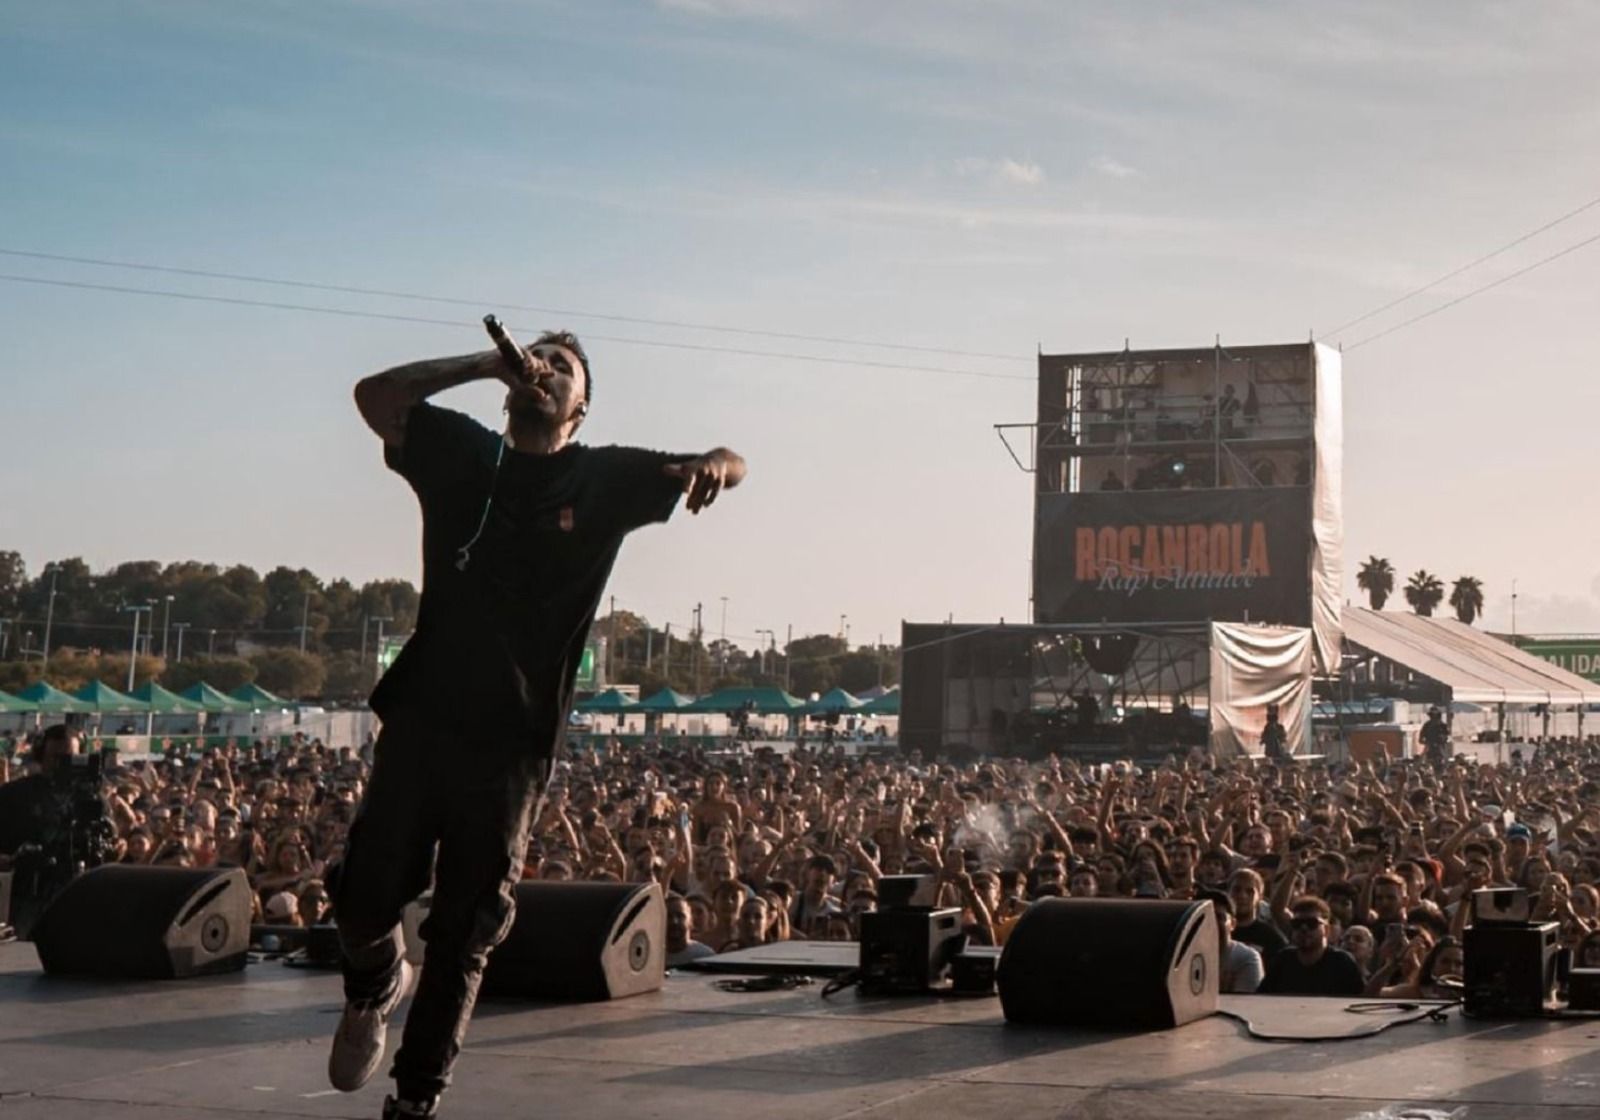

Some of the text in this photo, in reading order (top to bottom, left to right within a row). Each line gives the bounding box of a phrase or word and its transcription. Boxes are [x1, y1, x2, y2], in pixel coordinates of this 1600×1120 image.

[1075, 521, 1271, 581] ROCANROLA
[1095, 558, 1151, 597] Rap
[1537, 654, 1600, 674] LIDA
